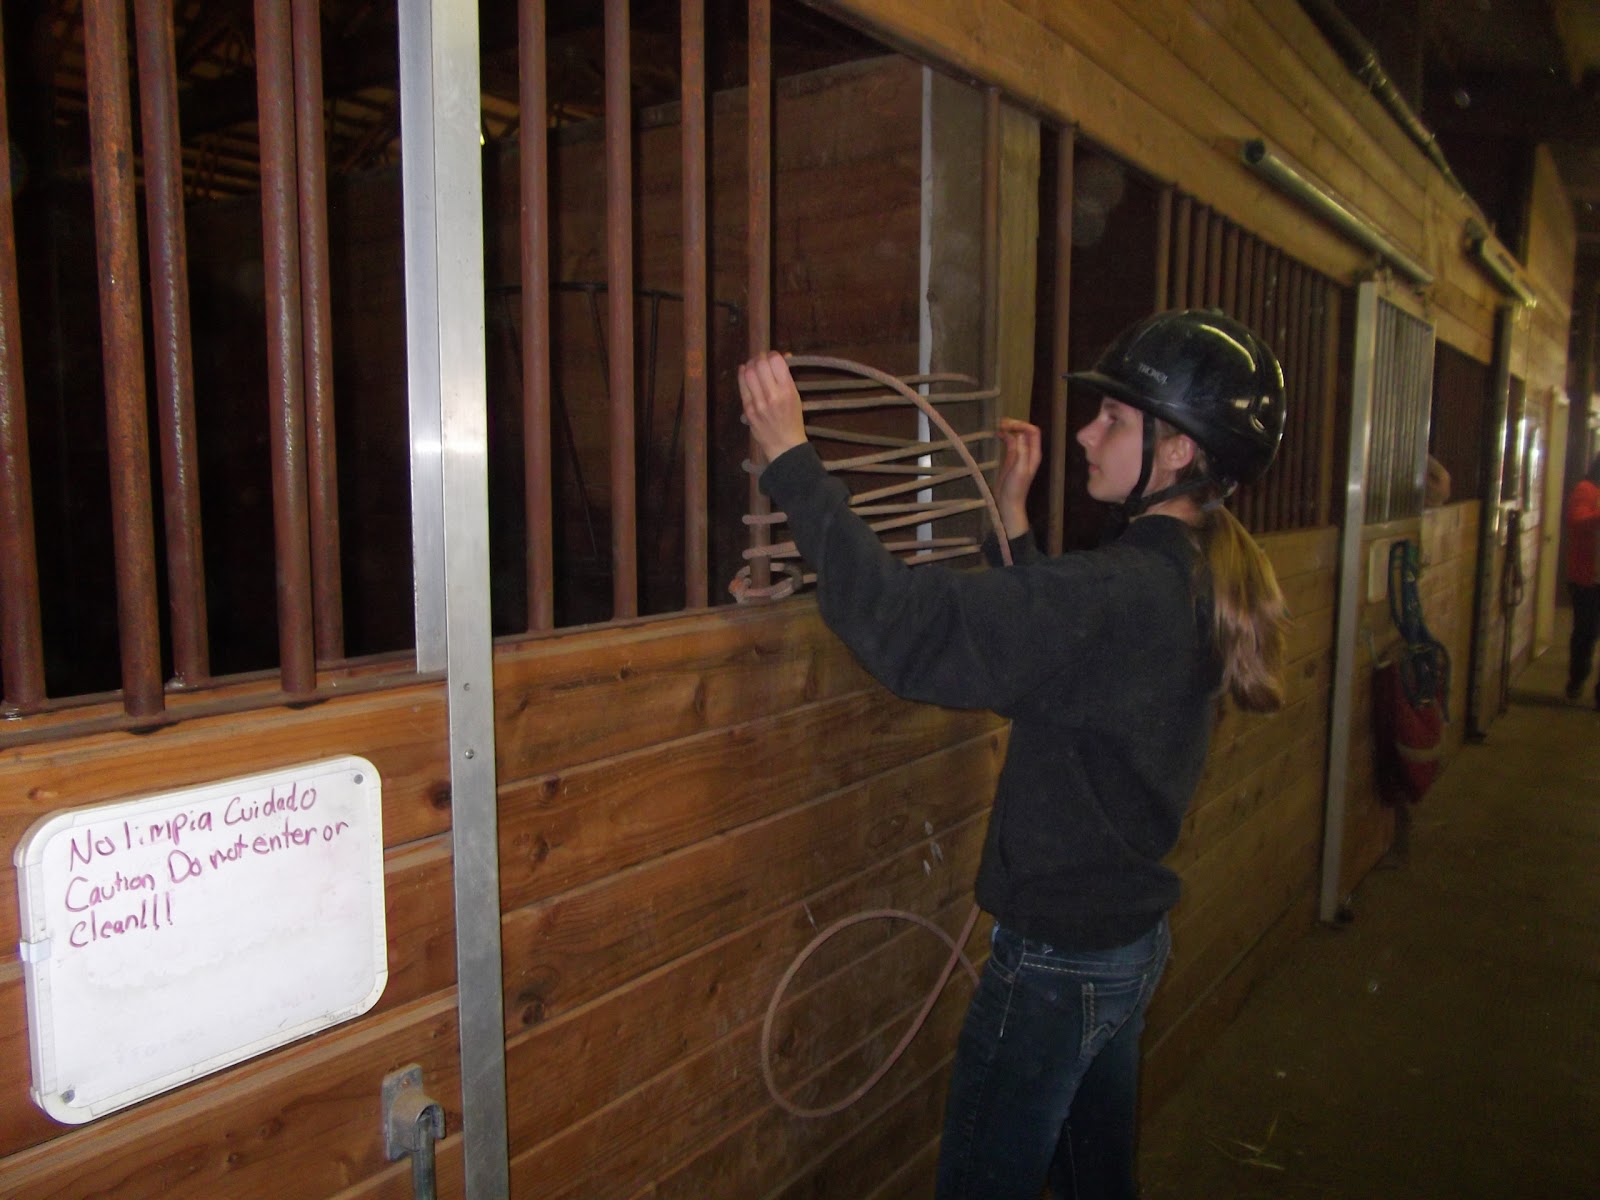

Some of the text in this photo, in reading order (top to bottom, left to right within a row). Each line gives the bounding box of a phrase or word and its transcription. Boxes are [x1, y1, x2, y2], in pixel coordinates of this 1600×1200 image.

[64, 871, 156, 913] Caution
[167, 849, 203, 884] Do
[322, 820, 349, 842] or
[69, 781, 317, 873] No limpia Cuidado
